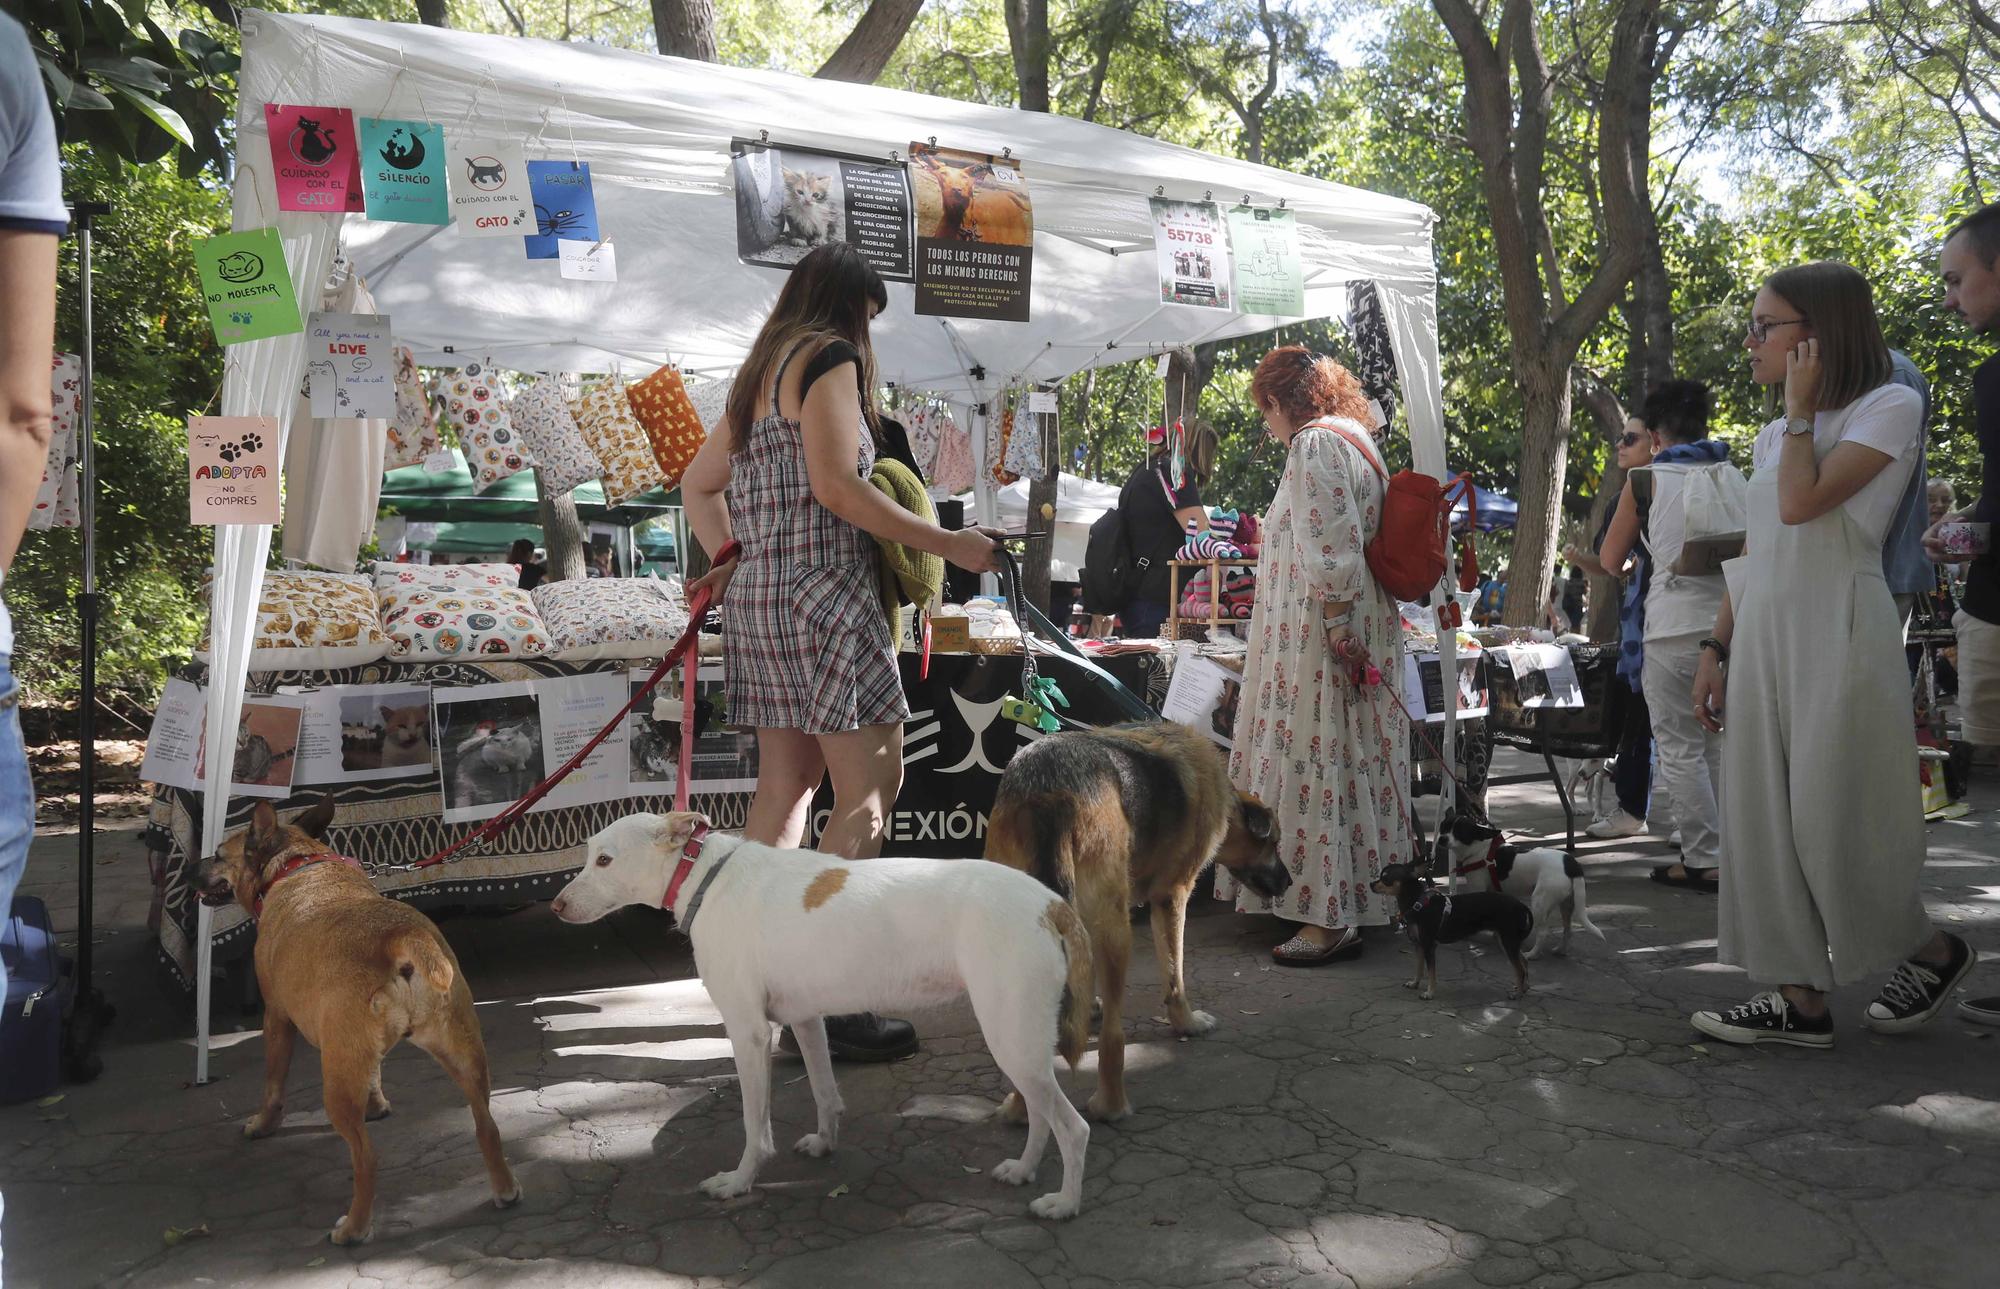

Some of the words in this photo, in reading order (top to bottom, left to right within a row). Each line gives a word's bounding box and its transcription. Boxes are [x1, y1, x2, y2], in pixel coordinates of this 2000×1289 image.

[307, 180, 325, 188] CON
[331, 181, 344, 189] EL
[544, 174, 589, 192] PASAR
[297, 192, 335, 204] GATO
[854, 202, 890, 210] CONDICIONA
[476, 216, 508, 228] GATO
[852, 210, 902, 222] RECONOCIMIENTO
[876, 222, 900, 230] COLONIA
[1168, 228, 1212, 244] 55738
[862, 240, 894, 248] PROBLEMAS
[928, 248, 952, 260] TODOS
[955, 250, 970, 262] LOS
[972, 252, 1002, 265] PERROS
[1005, 255, 1020, 266] CON
[928, 264, 942, 275] LOS
[944, 265, 976, 278] MISMOS
[978, 268, 1018, 282] DERECHOS
[208, 294, 222, 303] NO
[227, 284, 282, 299] MOLESTAR
[944, 298, 976, 306] PROTECCIÓN
[329, 344, 367, 355] LOVE
[196, 465, 266, 480] ADOPTA
[206, 496, 257, 506] COMPRES
